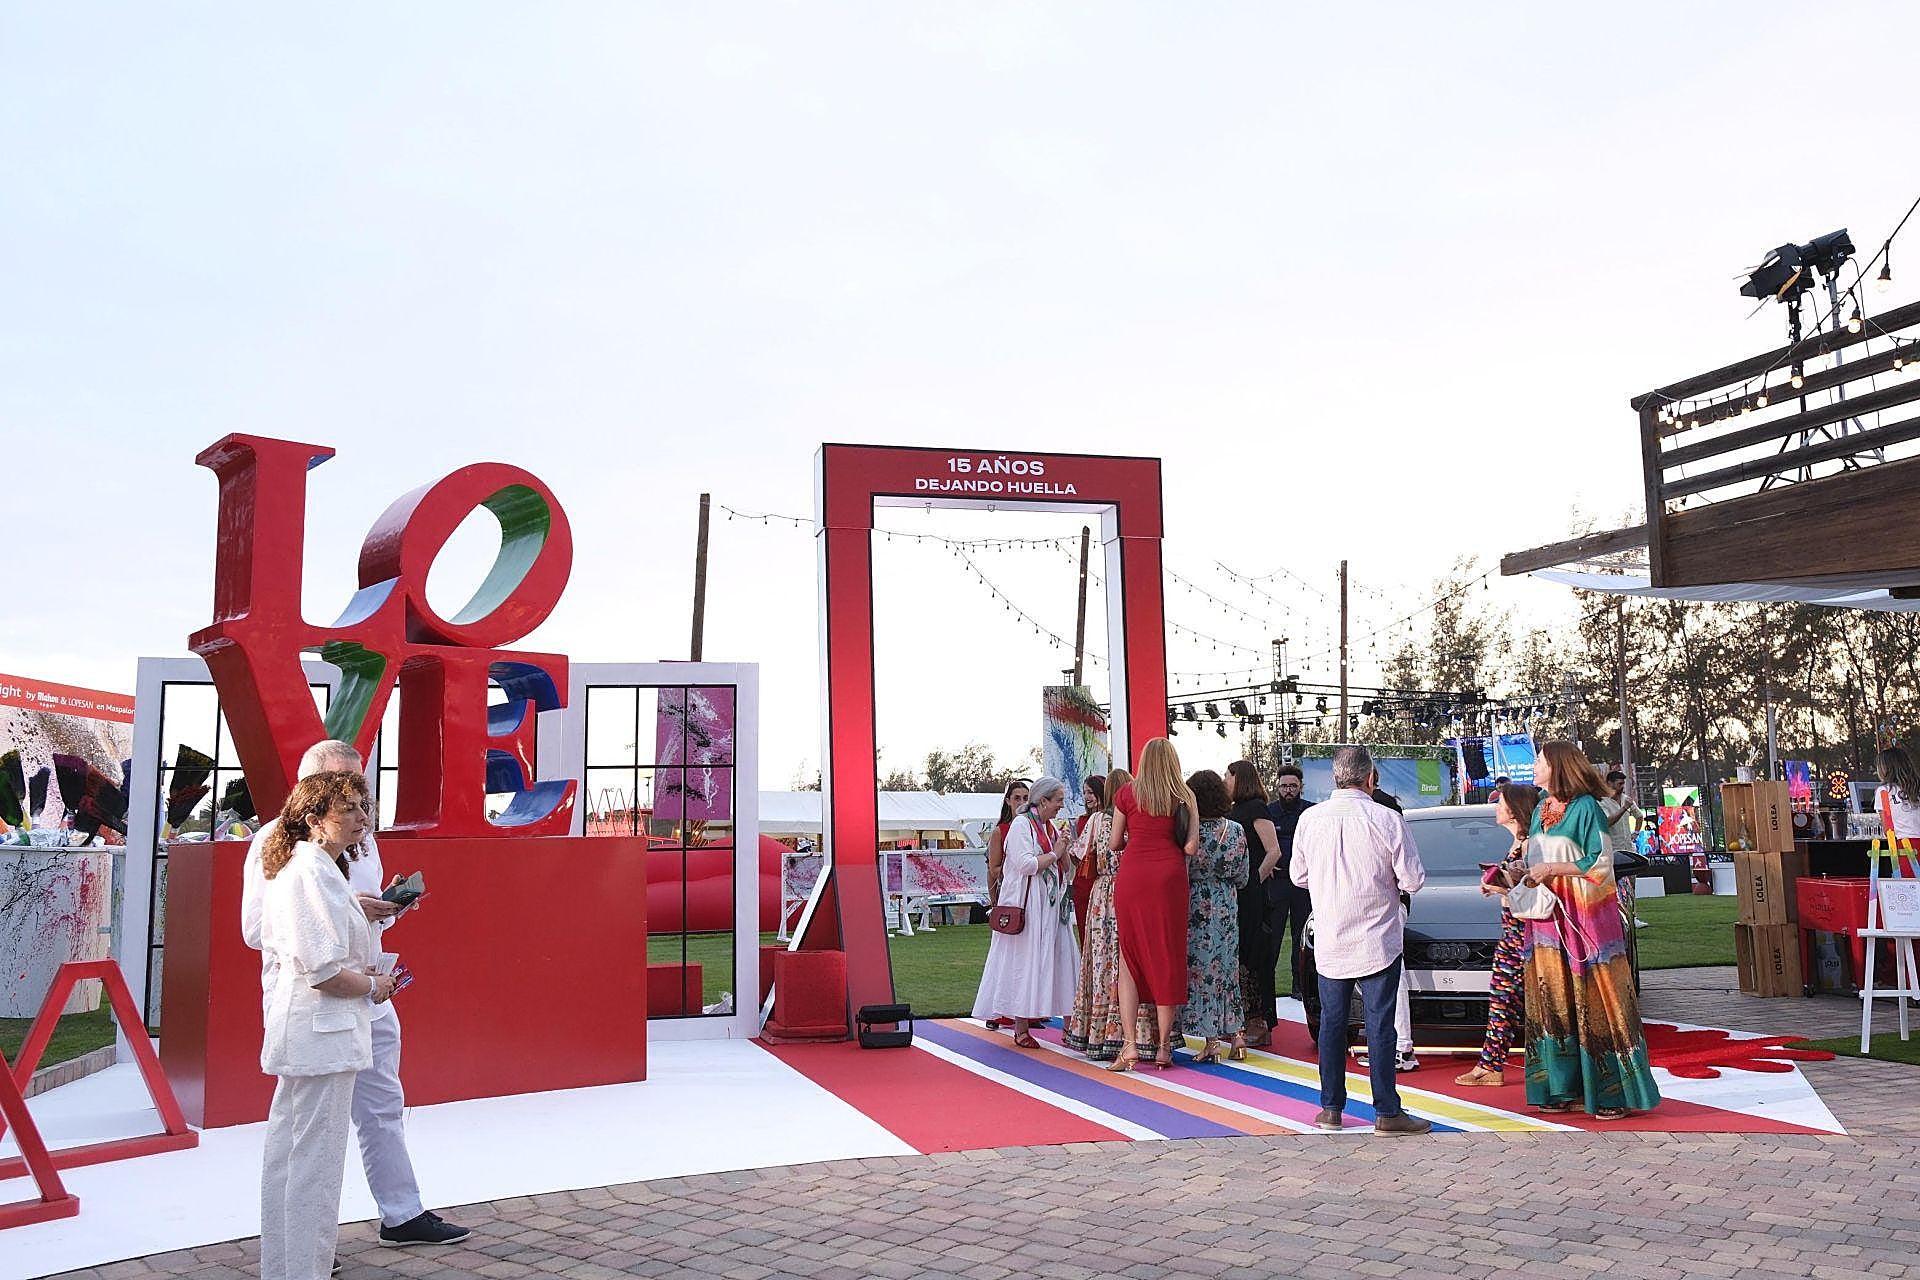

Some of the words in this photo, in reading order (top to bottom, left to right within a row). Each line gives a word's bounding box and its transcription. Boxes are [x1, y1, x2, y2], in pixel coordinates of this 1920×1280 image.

[947, 457, 972, 474] 15
[977, 456, 1045, 476] AÑOS
[915, 478, 1004, 493] DEJANDO
[1007, 481, 1077, 496] HUELLA
[26, 690, 36, 702] by
[60, 696, 68, 705] &
[68, 698, 94, 709] LOPESAN
[1770, 804, 1779, 831] LOLEA
[1669, 832, 1703, 845] LOPESAN
[1756, 875, 1765, 903] LOLEA
[1775, 947, 1784, 975] LOLEA
[1442, 977, 1454, 985] S5
